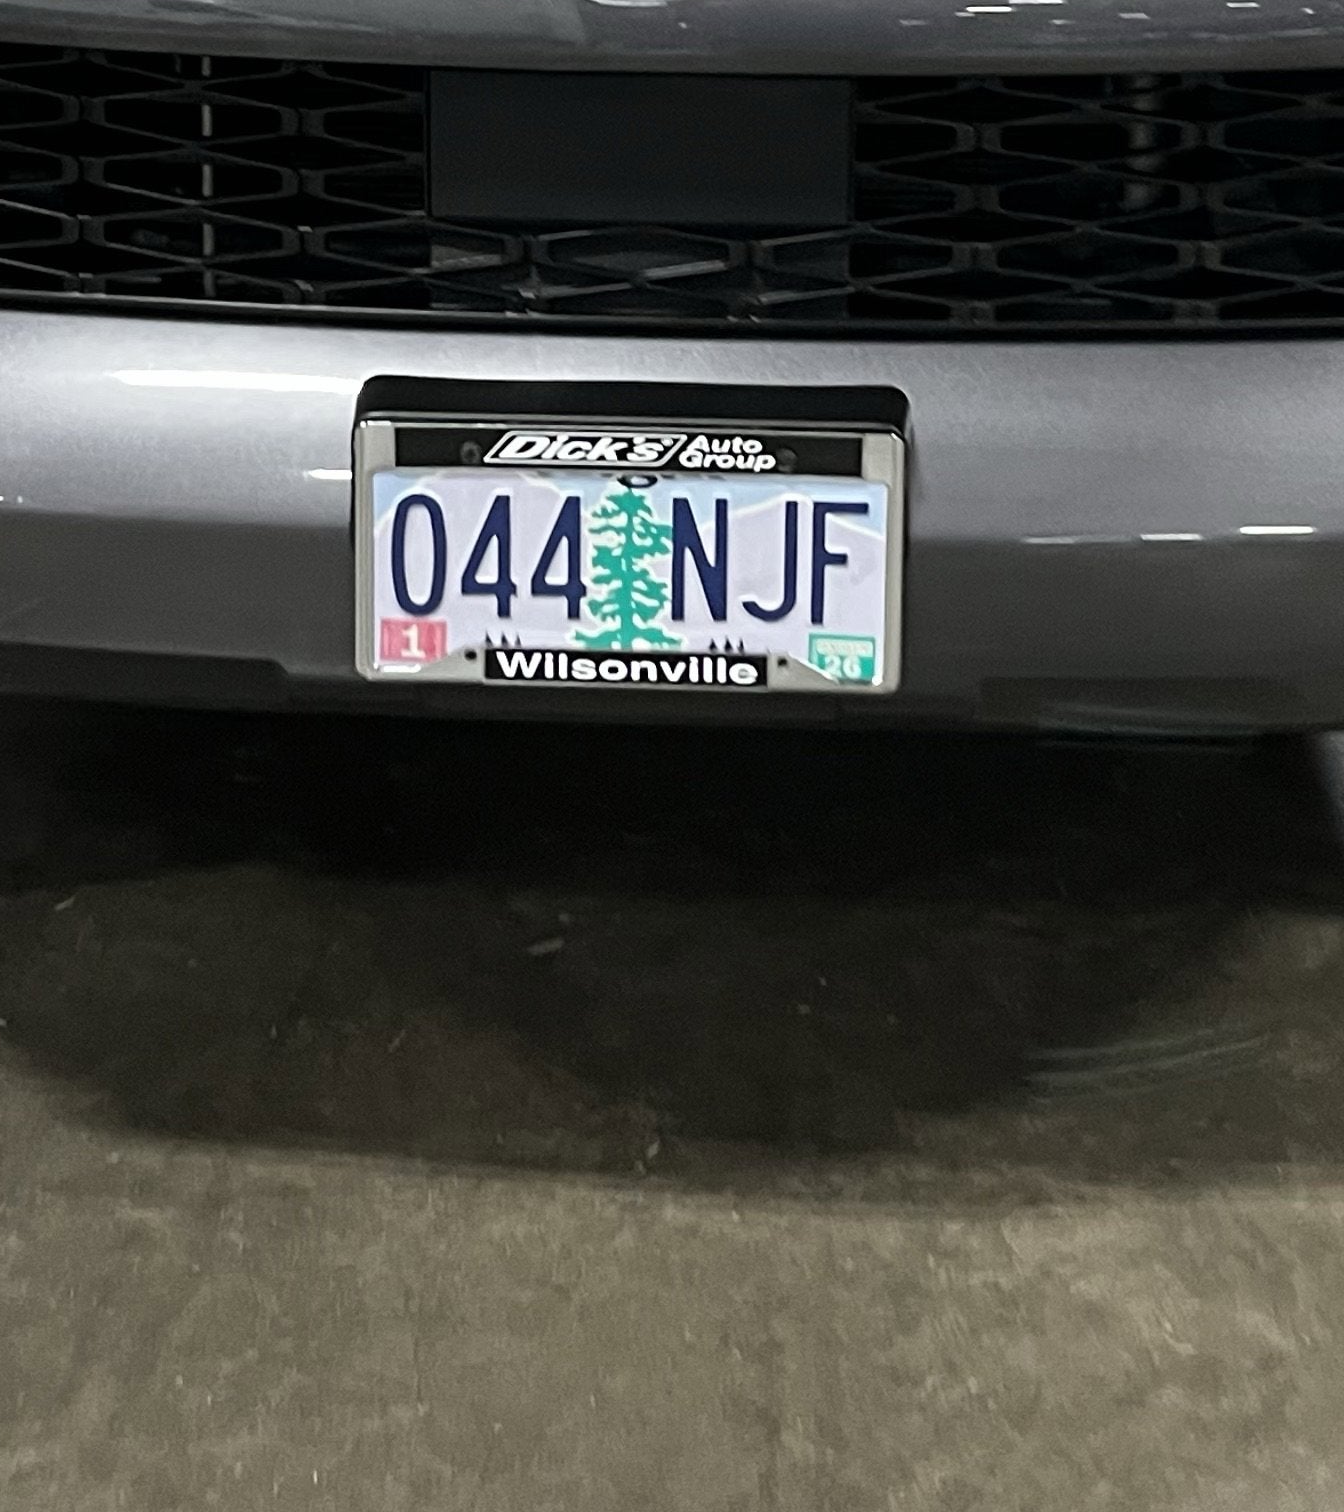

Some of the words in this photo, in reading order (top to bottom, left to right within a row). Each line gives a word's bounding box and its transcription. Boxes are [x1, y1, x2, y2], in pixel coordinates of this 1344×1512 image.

[679, 450, 776, 472] Group
[686, 435, 763, 454] Auto
[391, 493, 586, 620] 044
[671, 496, 869, 625] NJF
[401, 624, 426, 658] 1
[495, 650, 758, 684] Wilsonville
